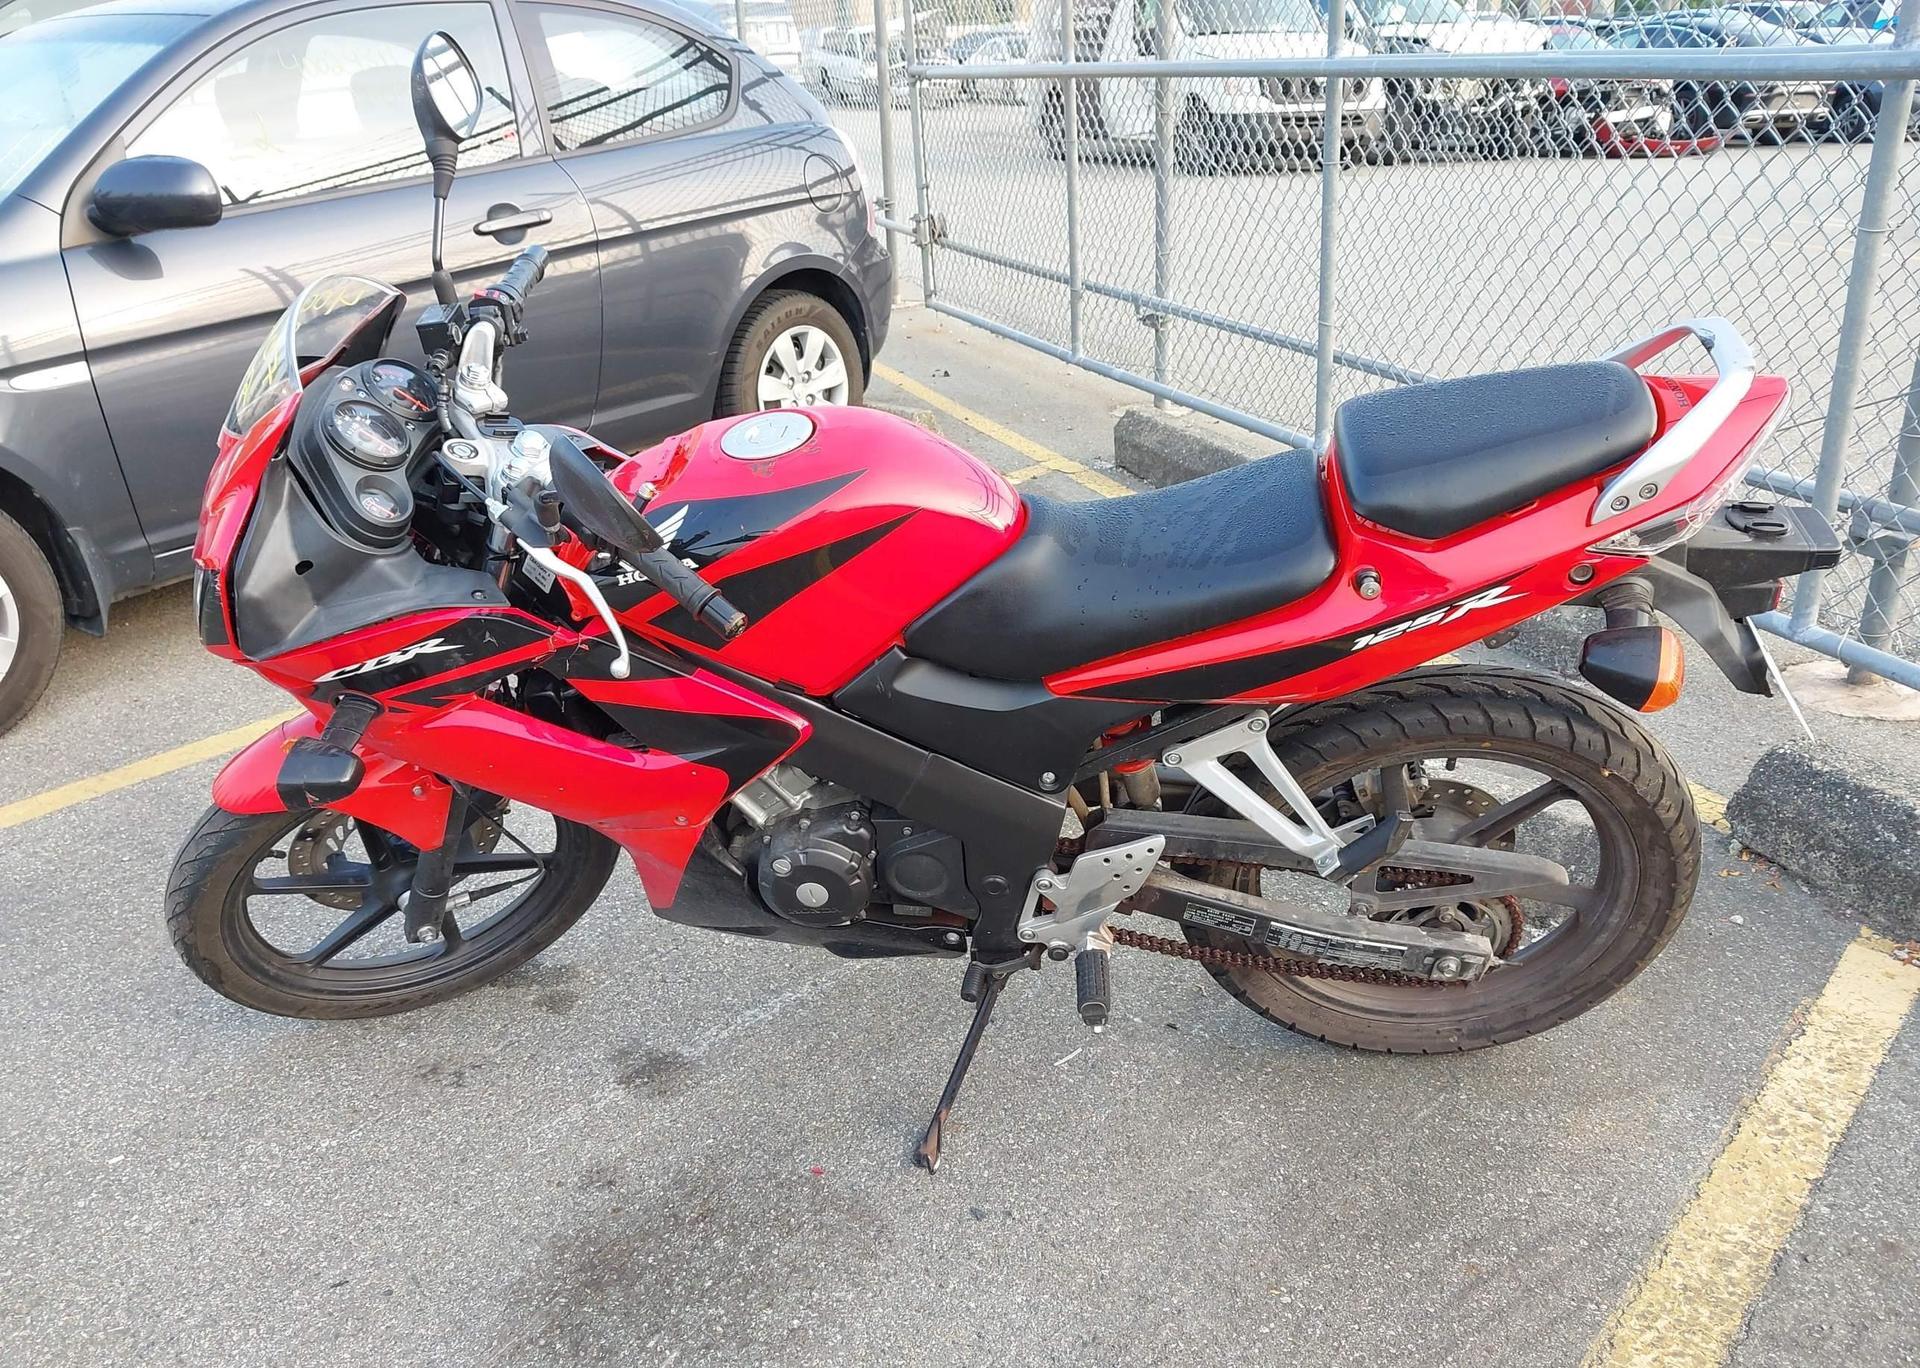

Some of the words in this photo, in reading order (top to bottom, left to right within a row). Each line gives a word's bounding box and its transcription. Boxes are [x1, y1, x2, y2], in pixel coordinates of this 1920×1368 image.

[616, 558, 699, 586] HOA
[1351, 585, 1531, 651] 125R
[312, 638, 464, 682] CBR
